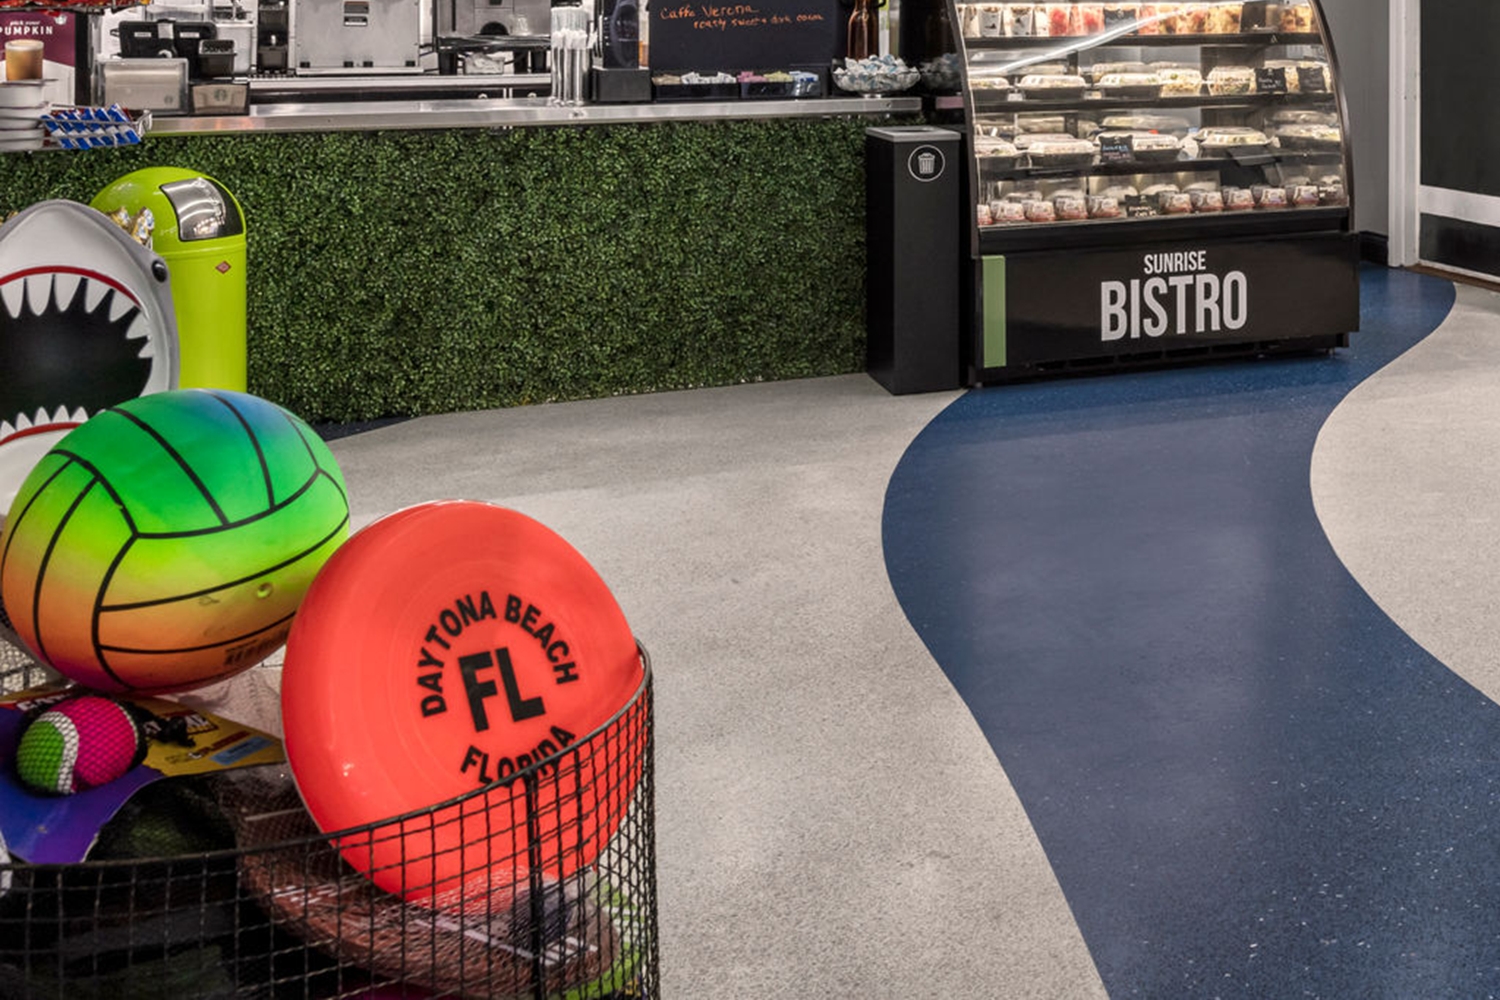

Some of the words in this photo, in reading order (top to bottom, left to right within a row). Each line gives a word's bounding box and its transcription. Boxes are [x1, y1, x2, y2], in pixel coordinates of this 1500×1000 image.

[1144, 250, 1206, 274] SUNRISE
[1101, 270, 1248, 341] BISTRO
[416, 590, 497, 718] DAYTONA
[504, 594, 579, 684] BEACH
[458, 647, 546, 732] FL
[460, 725, 576, 787] FLORIDA
